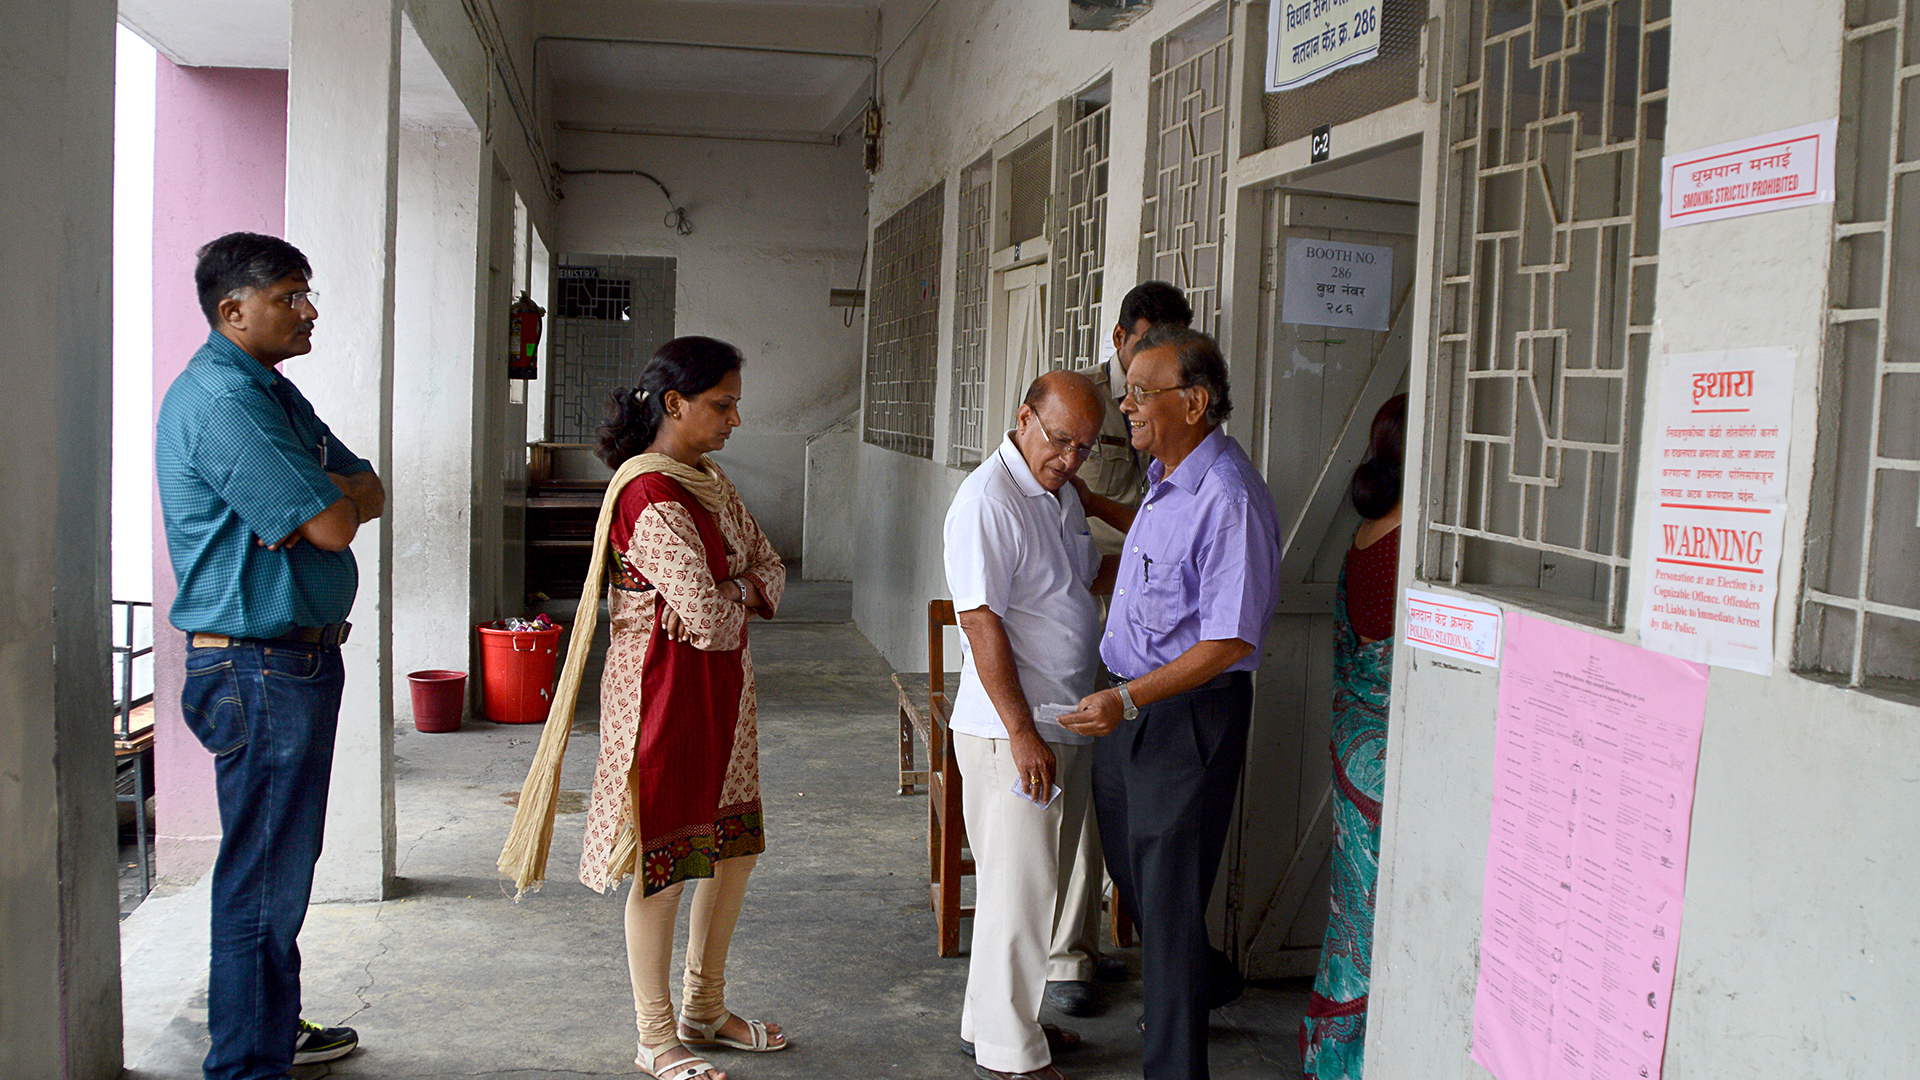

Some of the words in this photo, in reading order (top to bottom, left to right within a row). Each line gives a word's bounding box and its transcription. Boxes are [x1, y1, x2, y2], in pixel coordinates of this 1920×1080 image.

[1286, 1, 1311, 32] विधान
[1292, 34, 1320, 64] मतदान
[1353, 5, 1377, 39] 286
[1313, 132, 1329, 156] C-2
[1691, 162, 1743, 188] धूम्रपान
[1750, 146, 1793, 171] मनाई
[1682, 191, 1714, 209] SMOKING
[1715, 183, 1751, 205] STRICTLY
[1751, 174, 1799, 197] PROHIBITED
[1306, 246, 1352, 262] BOOTH
[1355, 251, 1377, 265] NO.
[558, 269, 596, 278] EMISTRY
[1331, 266, 1352, 279] 286
[1692, 370, 1755, 406] इशारा
[1663, 524, 1763, 565] WARNING
[1655, 568, 1694, 584] Personation
[1696, 575, 1704, 584] at
[1706, 577, 1715, 587] an
[1717, 575, 1748, 591] Election
[1749, 580, 1757, 592] is
[1758, 584, 1764, 592] a
[1653, 584, 1690, 600] Cognizable
[1691, 590, 1721, 604] Offence.
[1723, 594, 1760, 610] Offenders
[1410, 608, 1433, 623] मतदान
[1450, 614, 1474, 631] क्रमांक
[1650, 618, 1659, 631] by
[1662, 620, 1673, 631] the
[1675, 621, 1697, 635] Police.
[1653, 603, 1664, 612] are
[1666, 603, 1687, 616] Liable
[1689, 608, 1696, 617] to
[1697, 607, 1735, 624] Immediate
[1737, 615, 1760, 628] Arrest
[1410, 624, 1435, 641] POLLING
[1435, 630, 1461, 648] STATION
